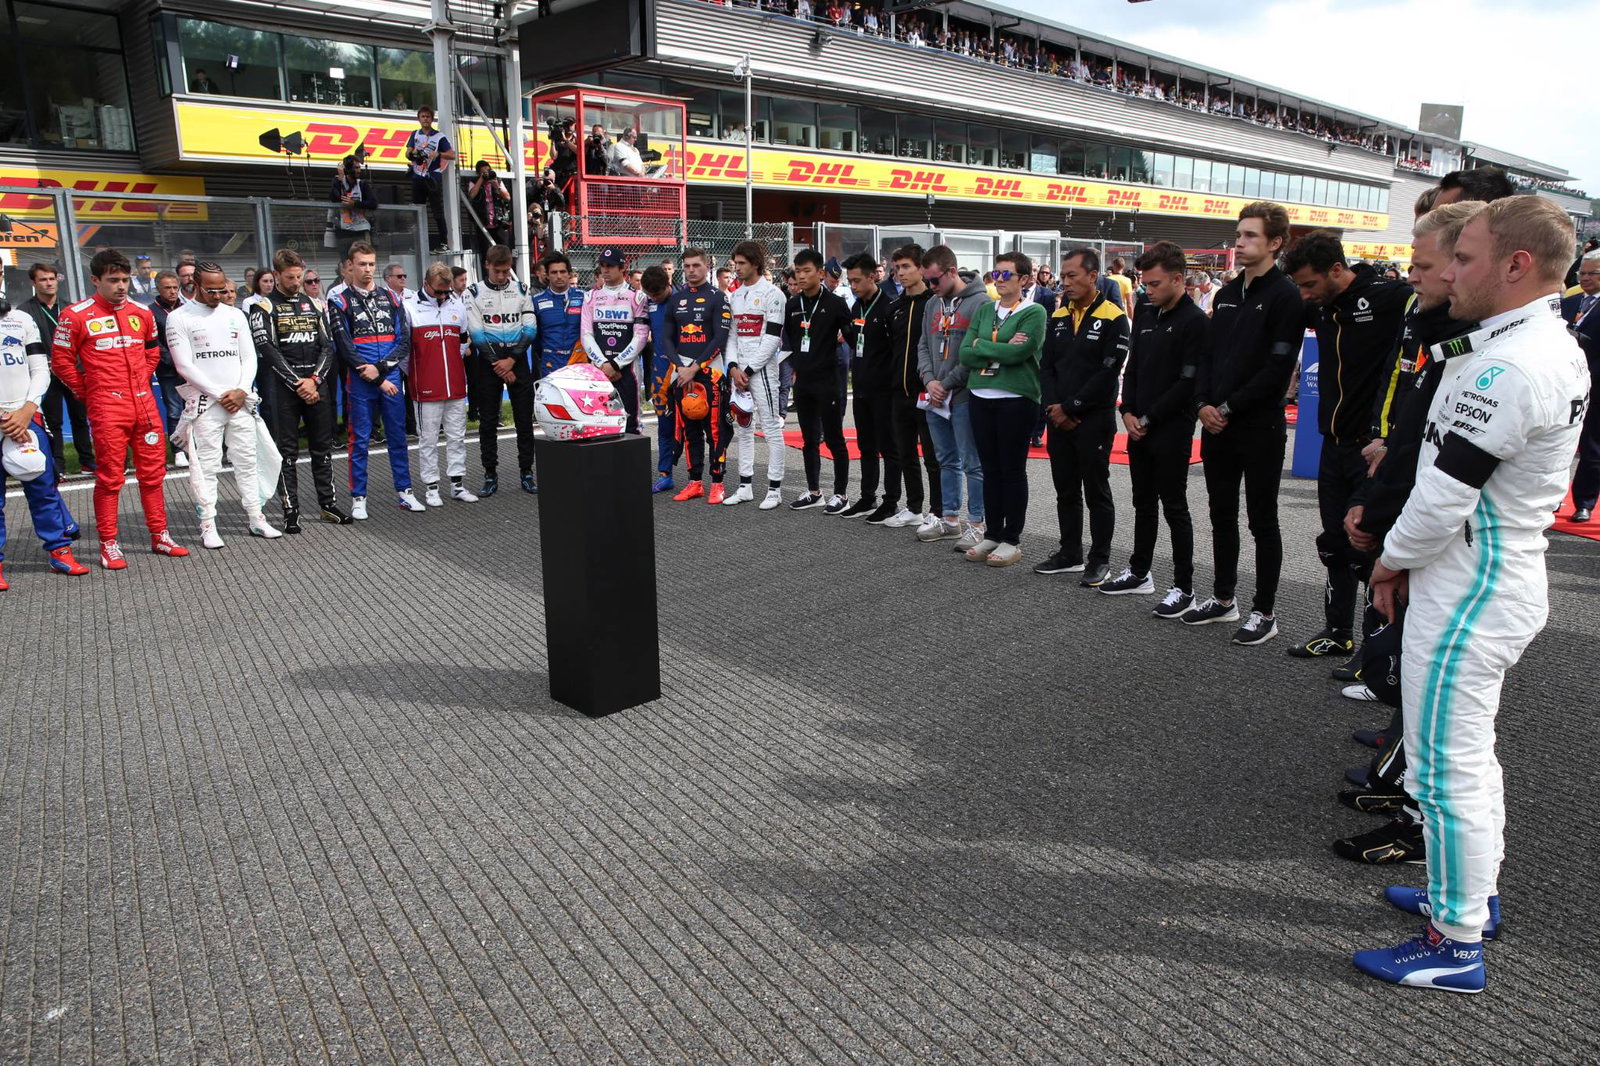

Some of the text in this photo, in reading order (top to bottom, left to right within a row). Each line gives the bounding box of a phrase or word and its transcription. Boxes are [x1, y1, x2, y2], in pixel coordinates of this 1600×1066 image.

[305, 123, 412, 158] DH
[663, 150, 750, 179] DHL
[788, 160, 858, 186] DHL
[889, 169, 948, 192] DHL
[0, 177, 167, 212] DHL
[975, 177, 1024, 198] DHL
[1046, 184, 1088, 203] DHL
[1107, 189, 1142, 208] DHL
[1159, 195, 1189, 211] DHL
[1204, 199, 1230, 214] DHL
[1287, 208, 1299, 220] HL
[1309, 210, 1328, 222] DHL
[1337, 213, 1354, 224] DHL
[1363, 215, 1378, 226] DHL
[605, 310, 629, 319] BWT
[597, 322, 628, 331] SportPesa
[1484, 315, 1535, 342] BOSE
[280, 331, 318, 343] HAAS
[680, 334, 706, 342] Red Bull
[621, 345, 634, 359] BWT
[1461, 390, 1499, 408] PETRONAS
[1455, 402, 1493, 424] EPSON
[1453, 949, 1480, 959] VB77
